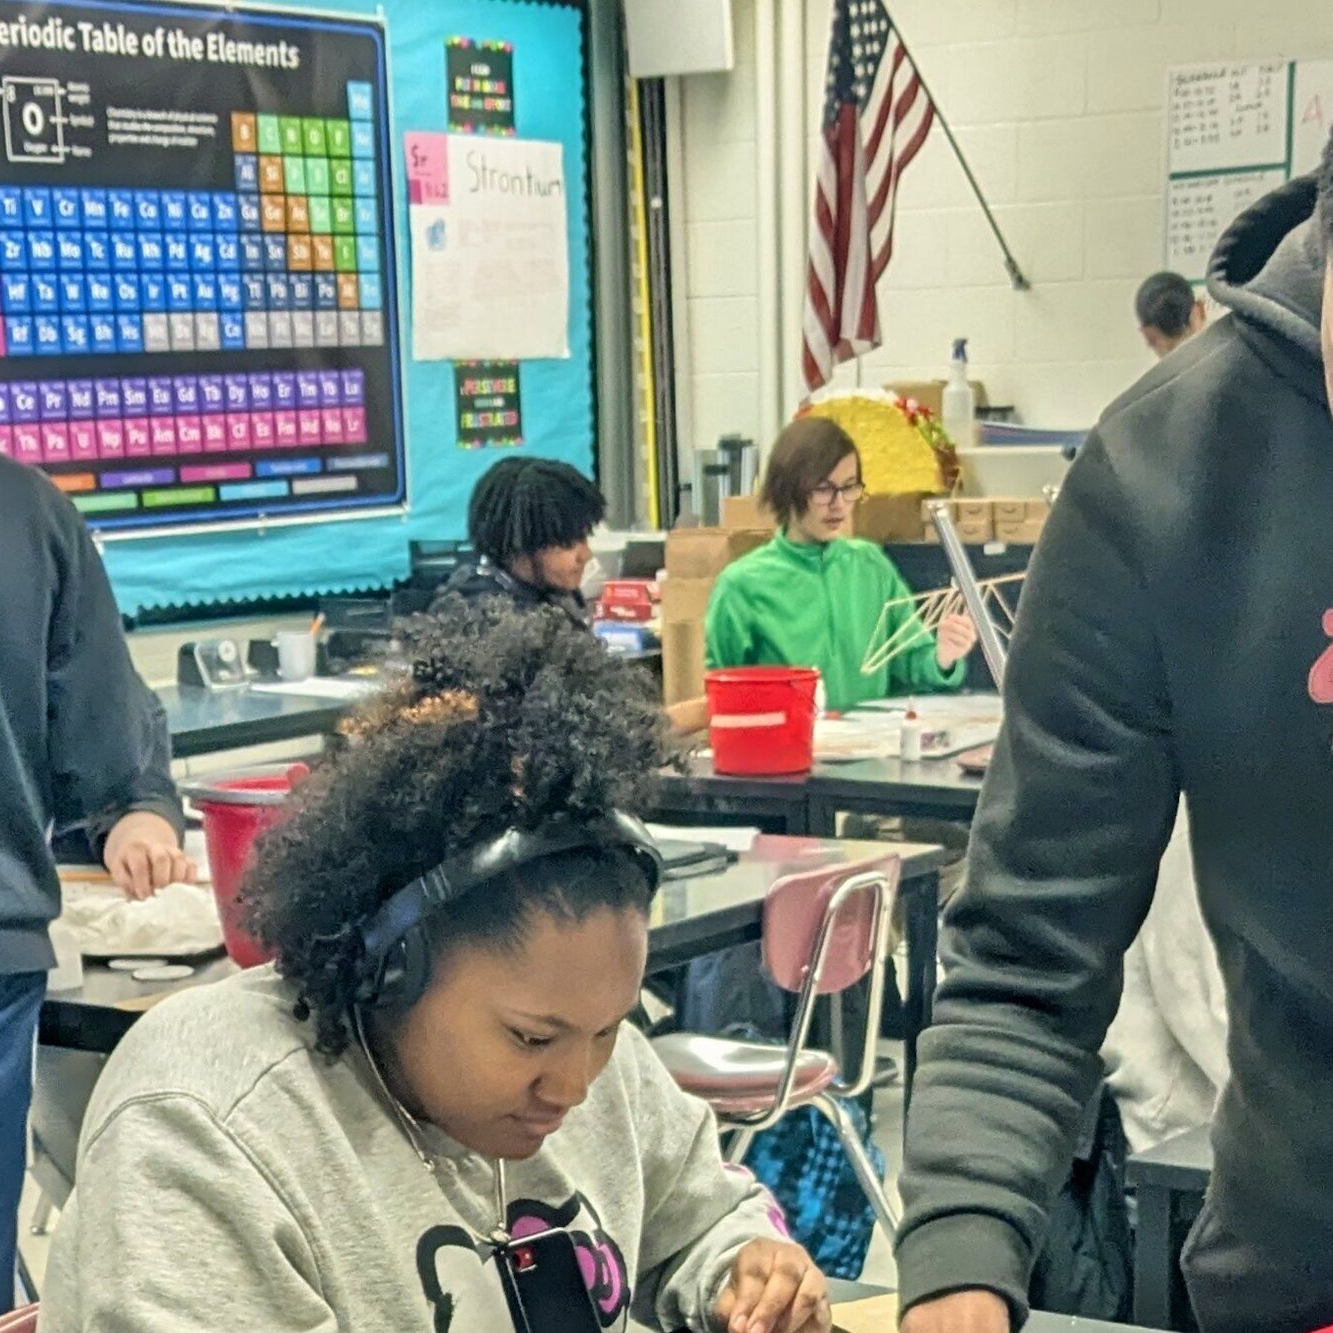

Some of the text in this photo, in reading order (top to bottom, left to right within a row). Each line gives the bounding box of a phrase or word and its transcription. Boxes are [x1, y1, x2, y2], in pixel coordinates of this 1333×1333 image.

[77, 22, 139, 56] Table
[141, 25, 165, 58] of
[166, 29, 204, 60] the
[206, 32, 301, 69] Elements
[21, 102, 45, 136] O
